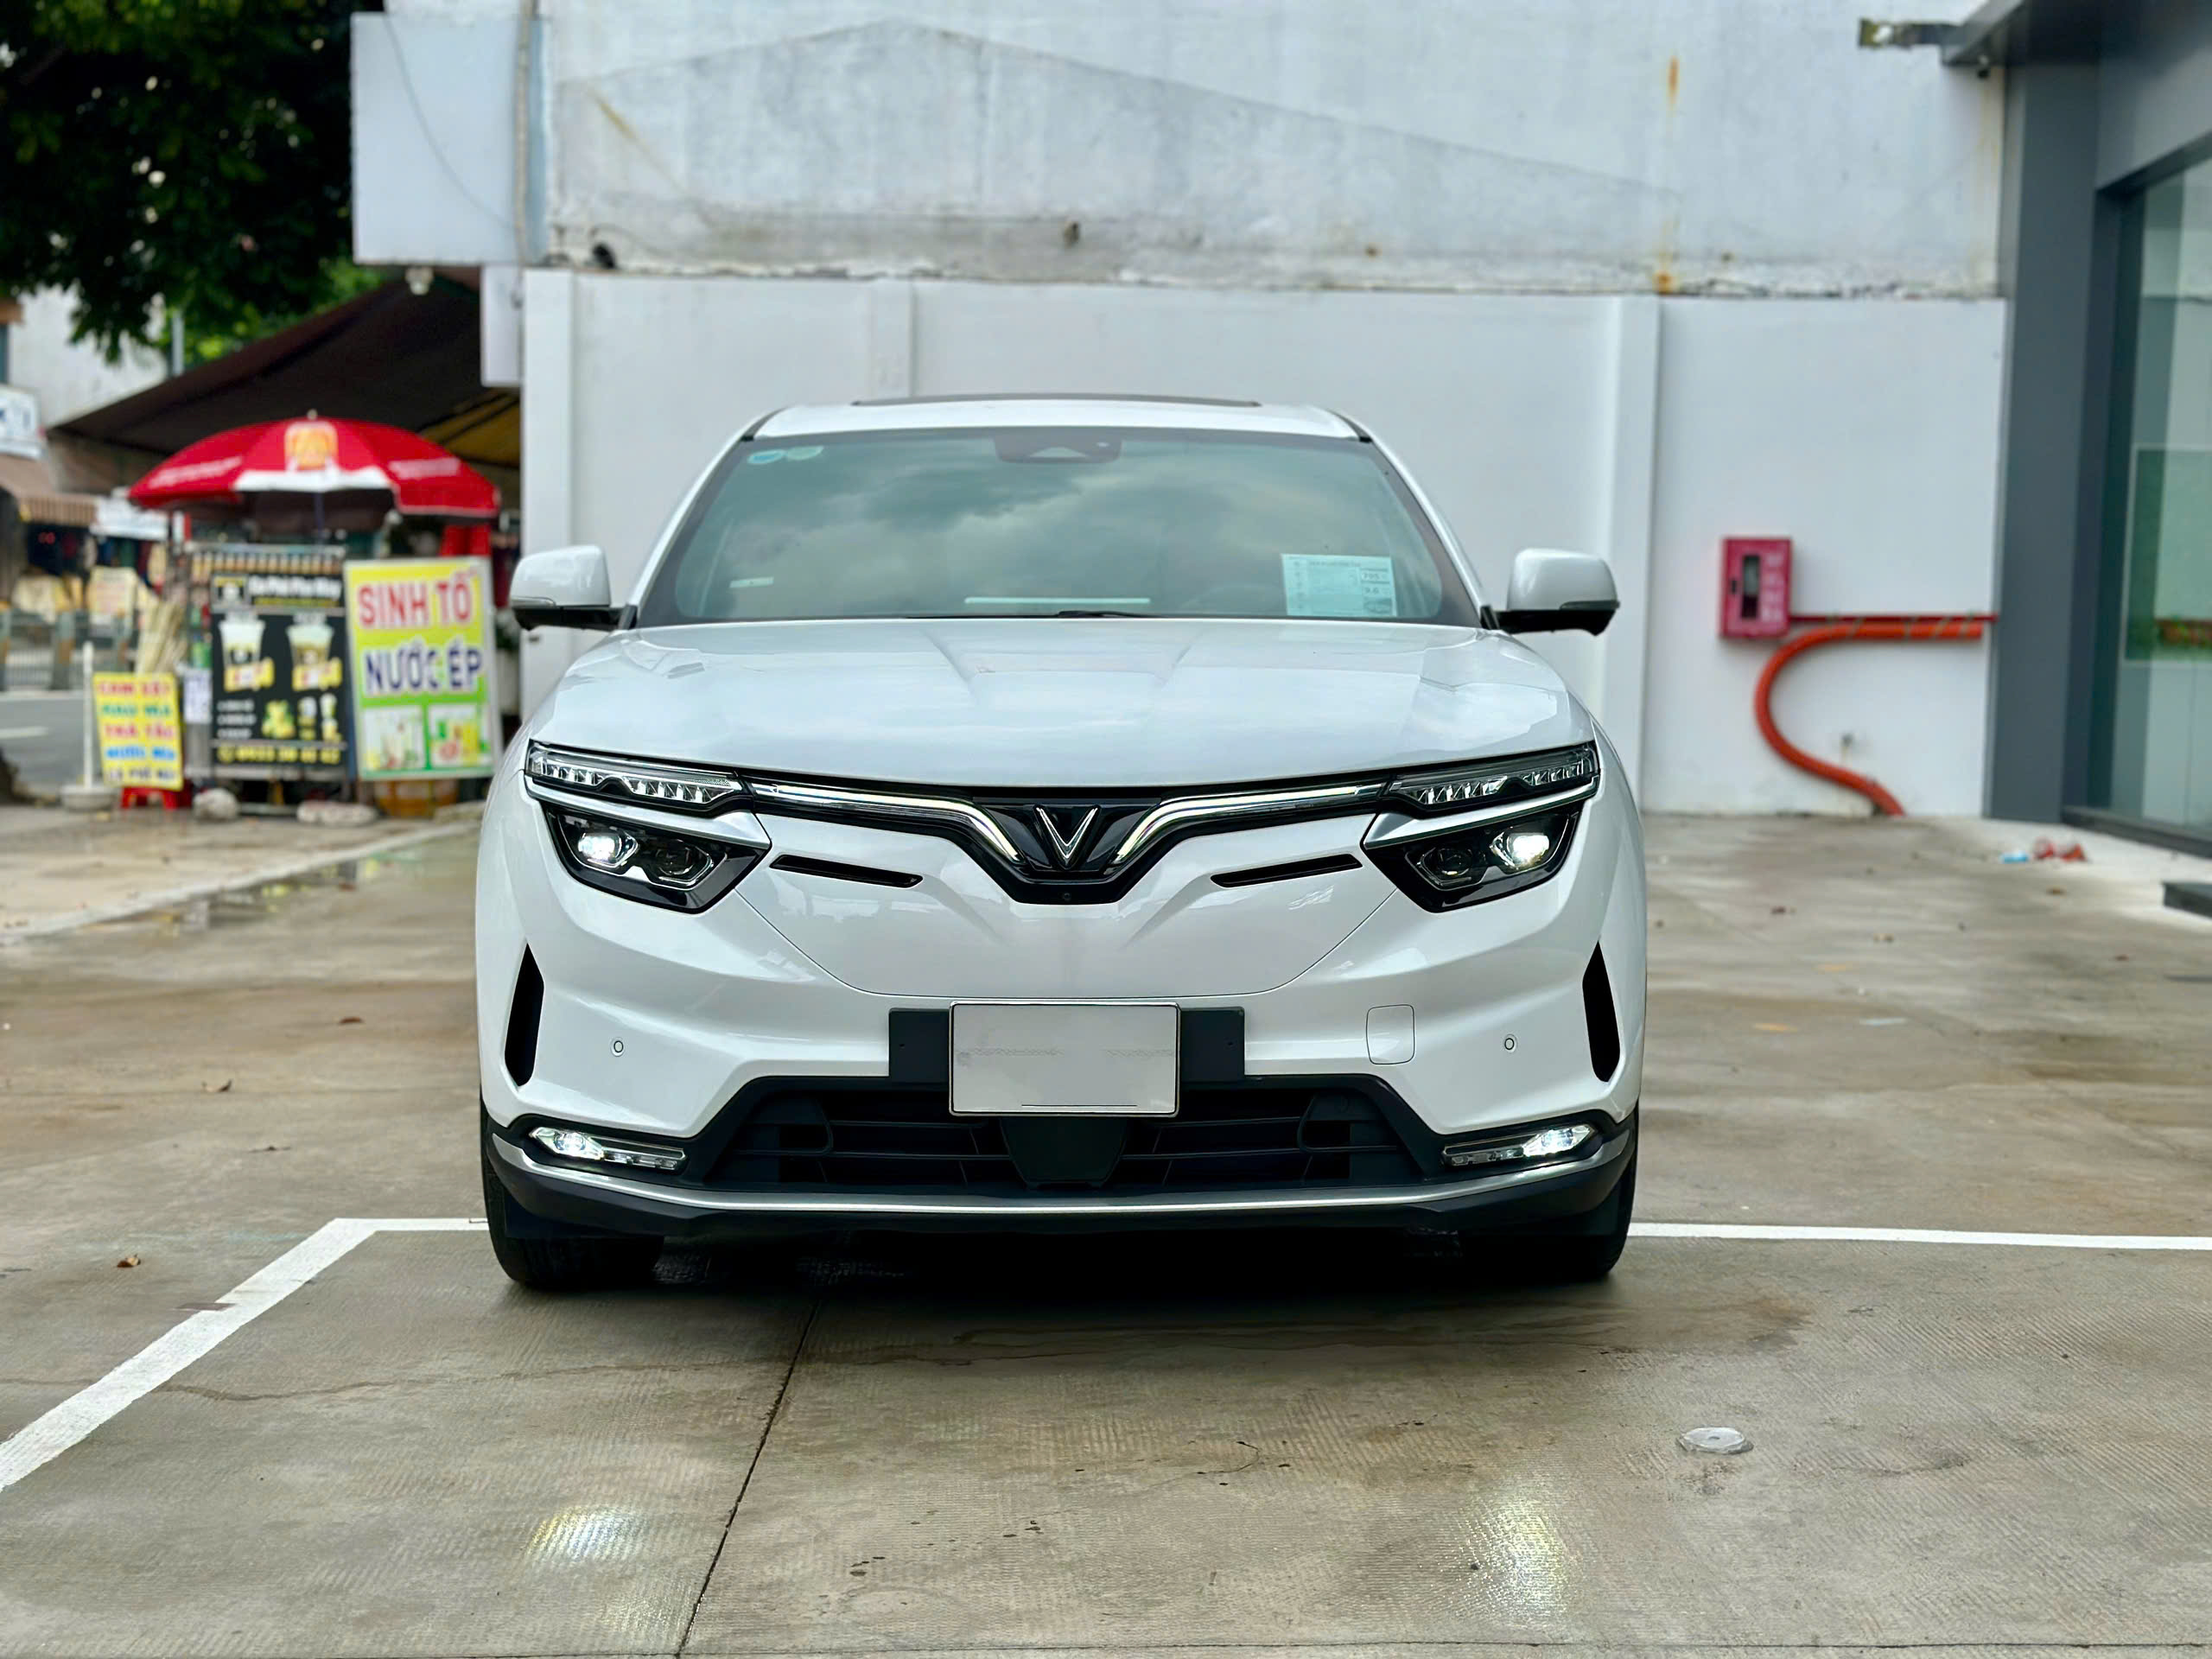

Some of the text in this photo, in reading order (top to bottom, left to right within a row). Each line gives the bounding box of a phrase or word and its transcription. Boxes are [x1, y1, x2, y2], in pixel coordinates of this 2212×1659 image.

[359, 568, 476, 626] SINH TỐ
[365, 640, 439, 692] NƯỚC
[448, 639, 481, 690] ÉP
